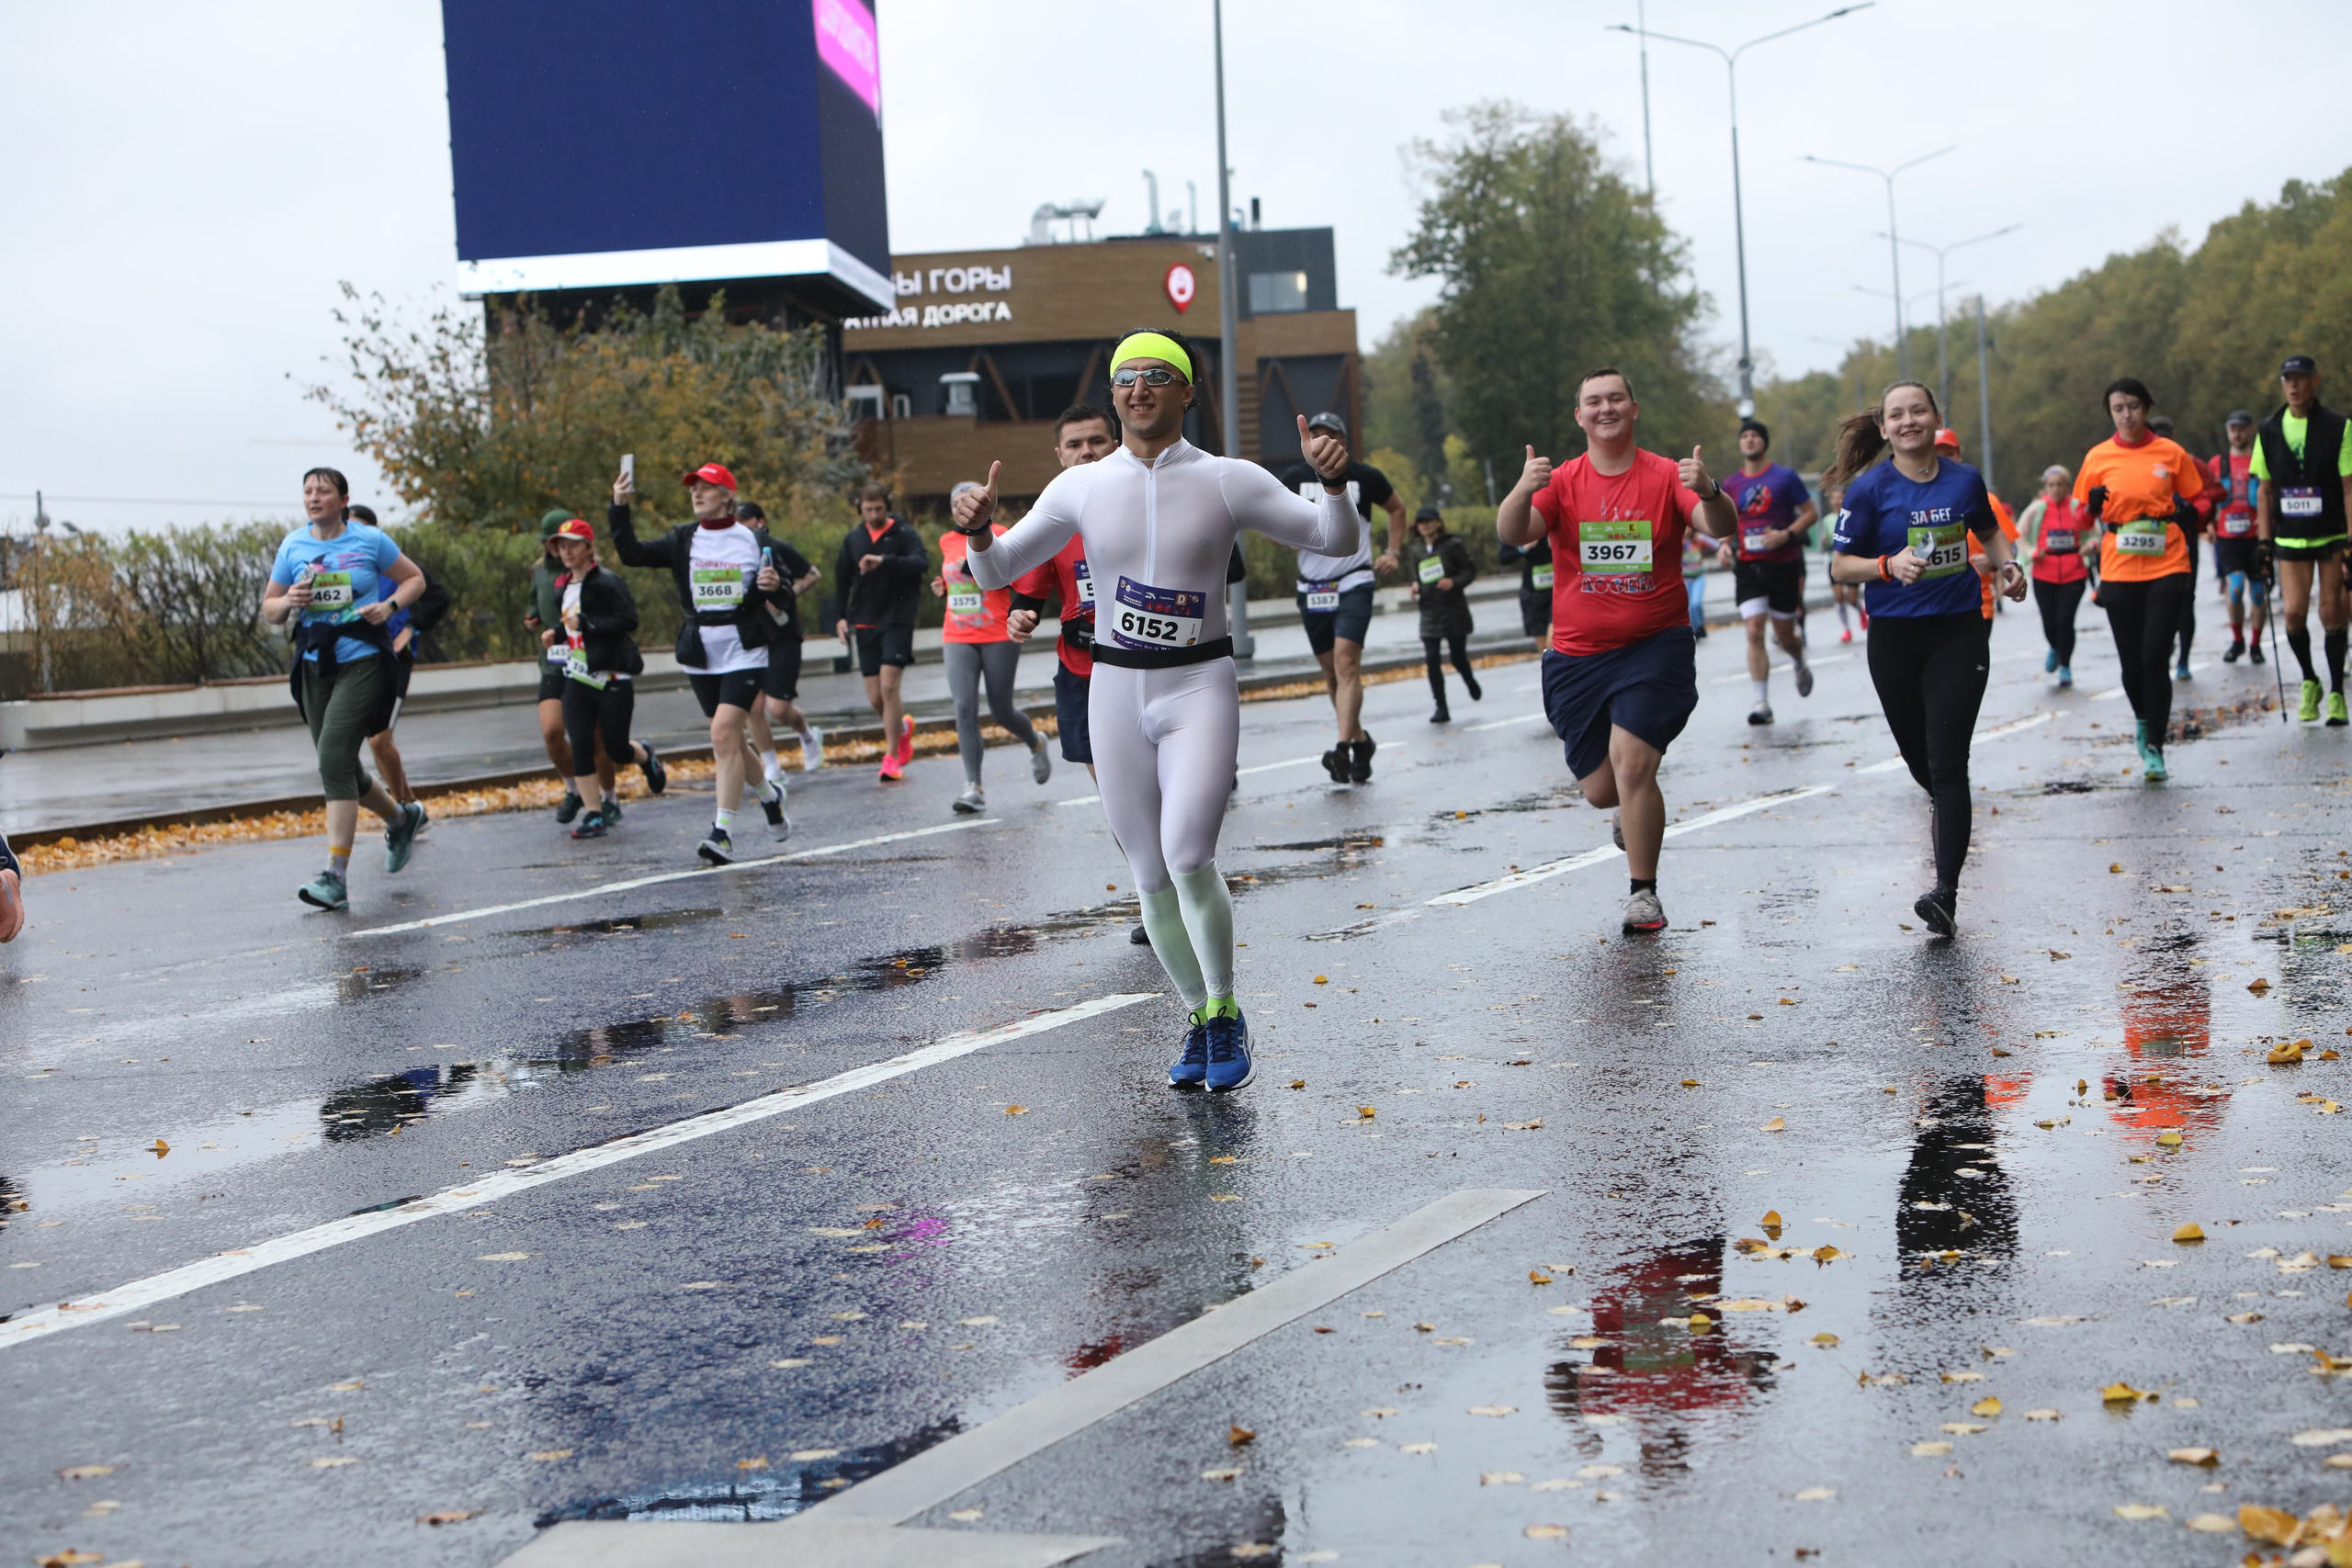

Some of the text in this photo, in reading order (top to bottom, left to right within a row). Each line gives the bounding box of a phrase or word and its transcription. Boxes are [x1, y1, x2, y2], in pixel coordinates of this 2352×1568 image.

[891, 265, 1012, 296] Ы ГОРЫ
[922, 300, 1012, 329] ДОРОГА
[2122, 536, 2155, 547] 3295
[1588, 545, 1637, 560] 3967
[1931, 547, 1961, 566] 615
[698, 585, 732, 596] 3668
[1177, 593, 1186, 604] D
[1121, 612, 1179, 641] 6152
